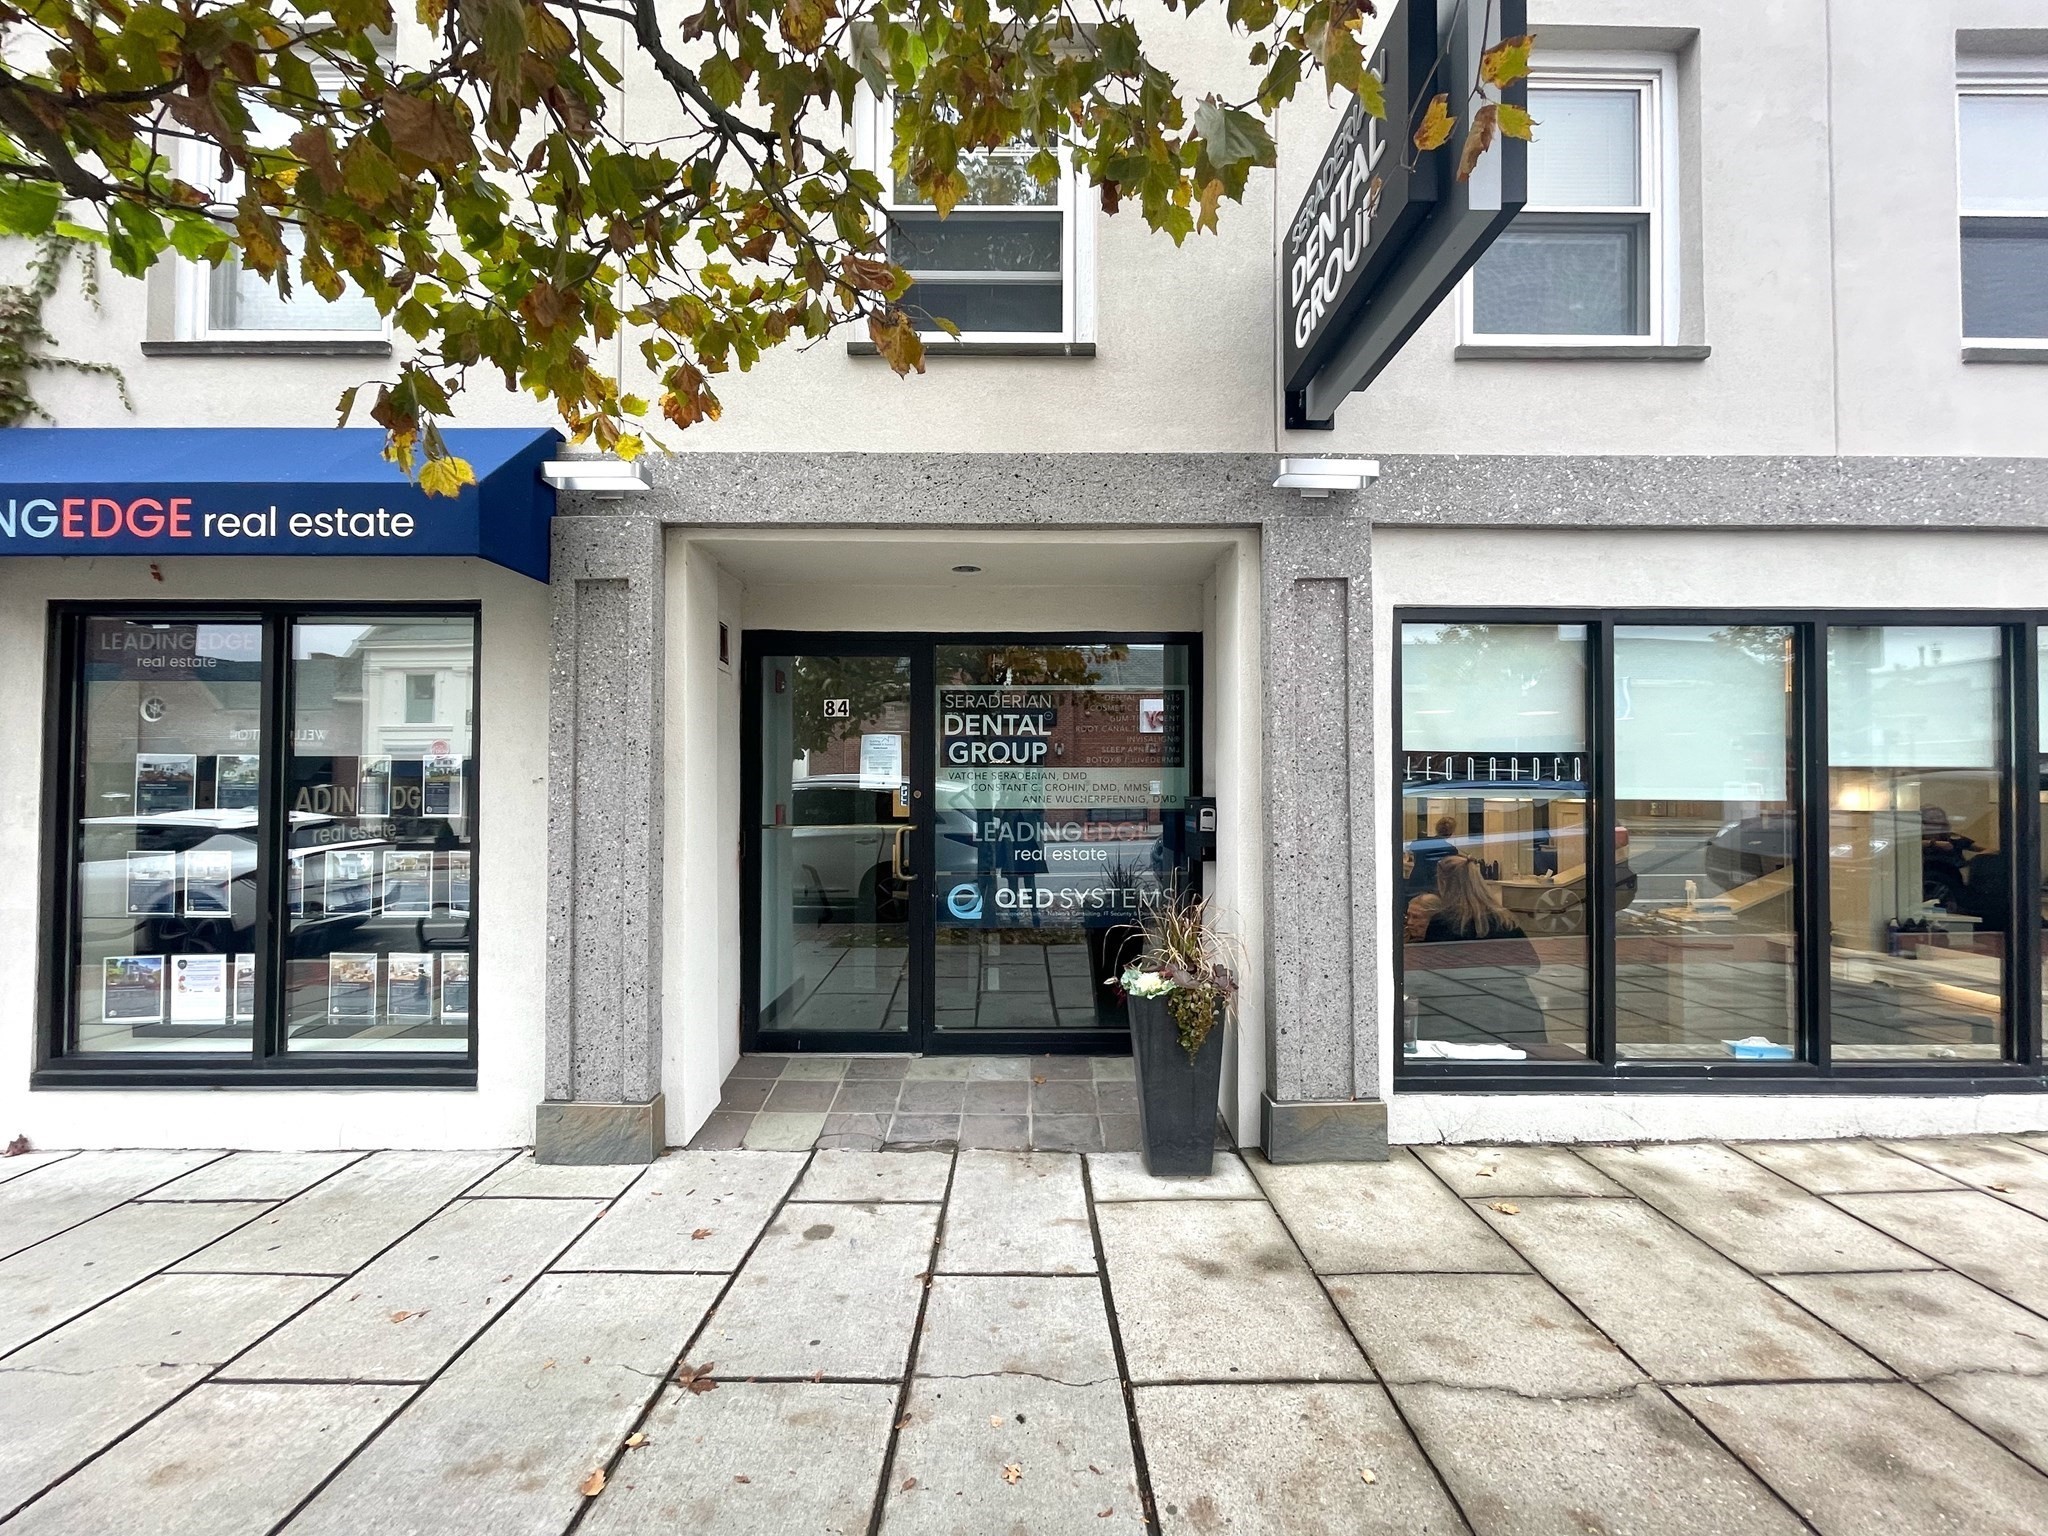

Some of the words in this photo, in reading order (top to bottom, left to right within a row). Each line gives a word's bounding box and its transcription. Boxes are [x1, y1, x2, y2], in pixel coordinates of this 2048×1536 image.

[1291, 116, 1386, 308] DENTAL
[204, 505, 276, 537] real
[289, 507, 415, 537] estate
[101, 632, 255, 650] LEADINGEDGE
[137, 656, 165, 668] real
[169, 656, 217, 668] estate
[825, 700, 849, 716] 84
[945, 694, 1052, 709] SERADERIAN
[1090, 704, 1132, 712] COSMETIC
[944, 714, 1052, 736] DENTAL
[1075, 725, 1098, 733] ROOT
[949, 741, 1048, 764] GROUP
[948, 771, 988, 780] VATCHE
[992, 771, 1059, 781] SERADERIAN,
[1062, 771, 1088, 780] DMD
[971, 783, 1028, 792] CONSTANT
[1045, 783, 1089, 793] CROHIN,
[1092, 783, 1120, 793] DMD,
[1022, 795, 1052, 804] ANNE
[1152, 795, 1177, 804] DMD
[312, 827, 345, 844] real
[351, 821, 397, 842] estate
[972, 821, 1147, 842] LEADINGEDGE
[1014, 847, 1047, 861] real
[1052, 847, 1108, 861] estate
[994, 887, 1054, 909] QED
